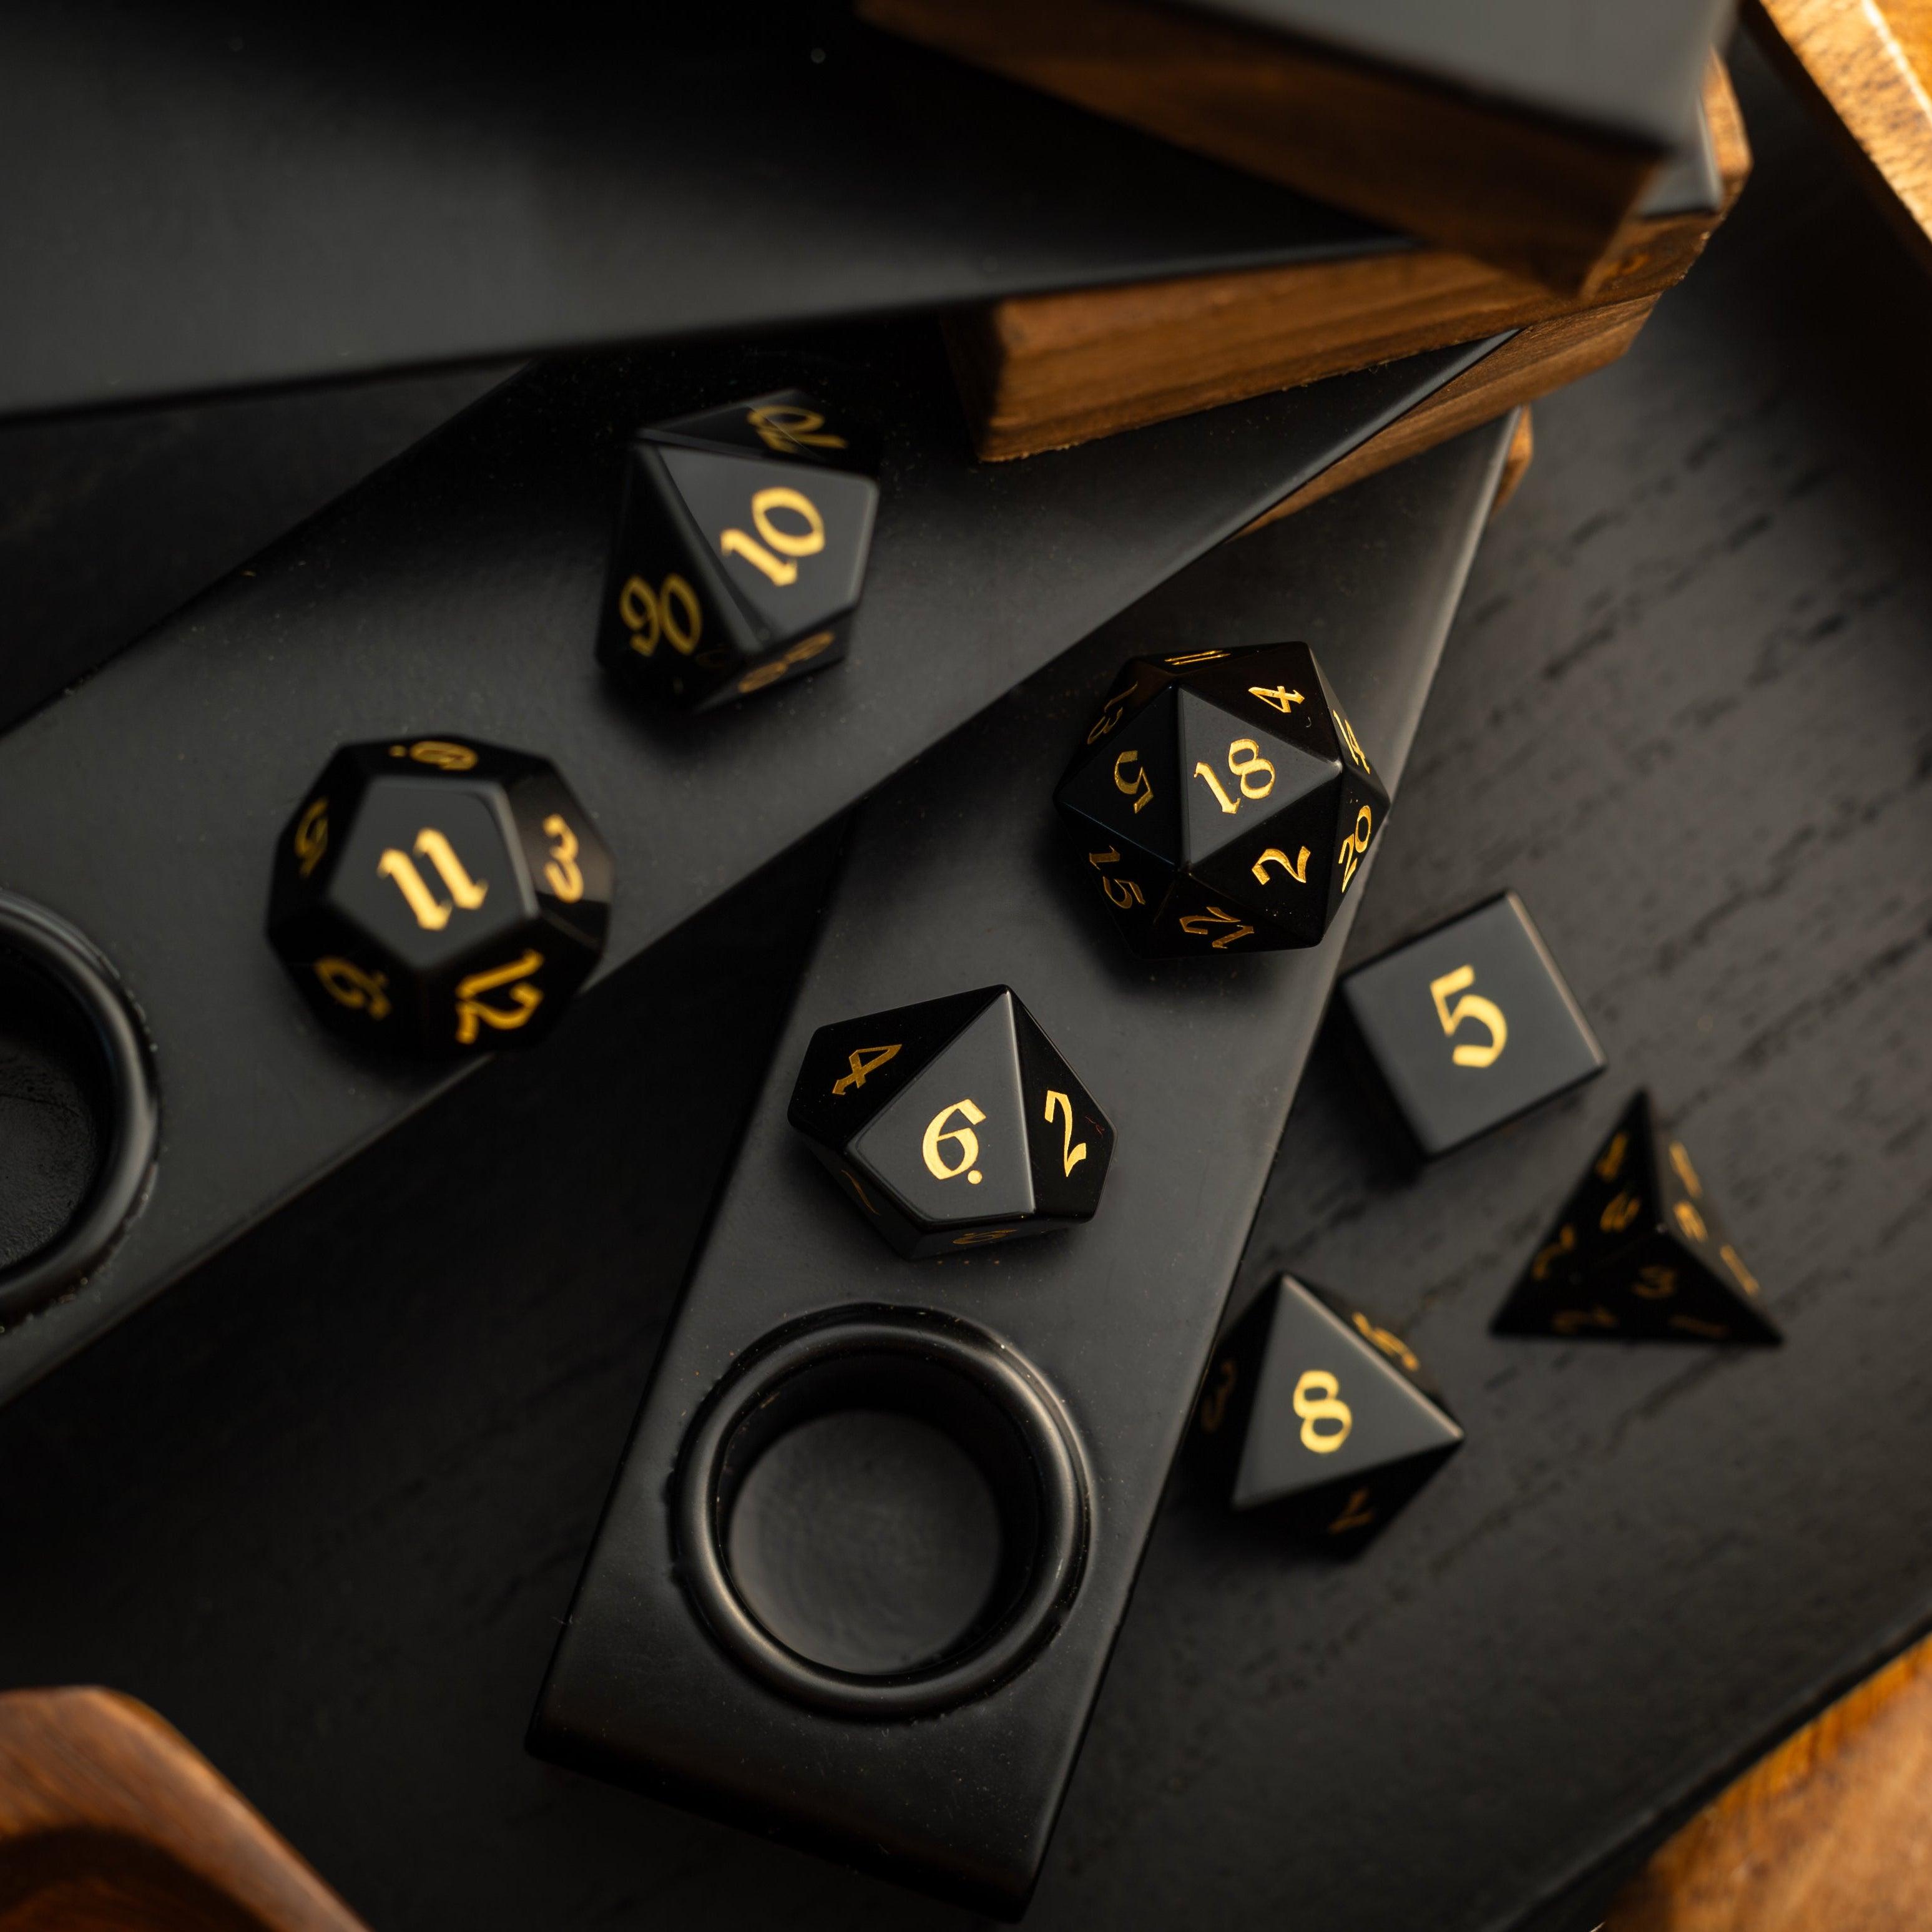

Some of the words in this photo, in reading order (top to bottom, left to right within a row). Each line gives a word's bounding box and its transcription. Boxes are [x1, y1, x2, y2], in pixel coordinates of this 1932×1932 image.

[720, 486, 825, 586] 10
[619, 573, 702, 655] 90
[1248, 686, 1305, 713] 4
[1114, 750, 1154, 814] 5
[1193, 738, 1277, 814] 18
[1333, 709, 1371, 774] 14
[377, 827, 489, 930] 11
[542, 813, 584, 903] 3
[1089, 845, 1147, 910] 15
[1251, 846, 1312, 885] 2
[1338, 805, 1372, 894] 20
[1179, 906, 1255, 949] 12
[456, 949, 543, 1044] 12
[1430, 964, 1508, 1068] 5
[831, 1044, 903, 1096] 4
[1044, 1089, 1087, 1177] 2
[1292, 1370, 1353, 1454] 8
